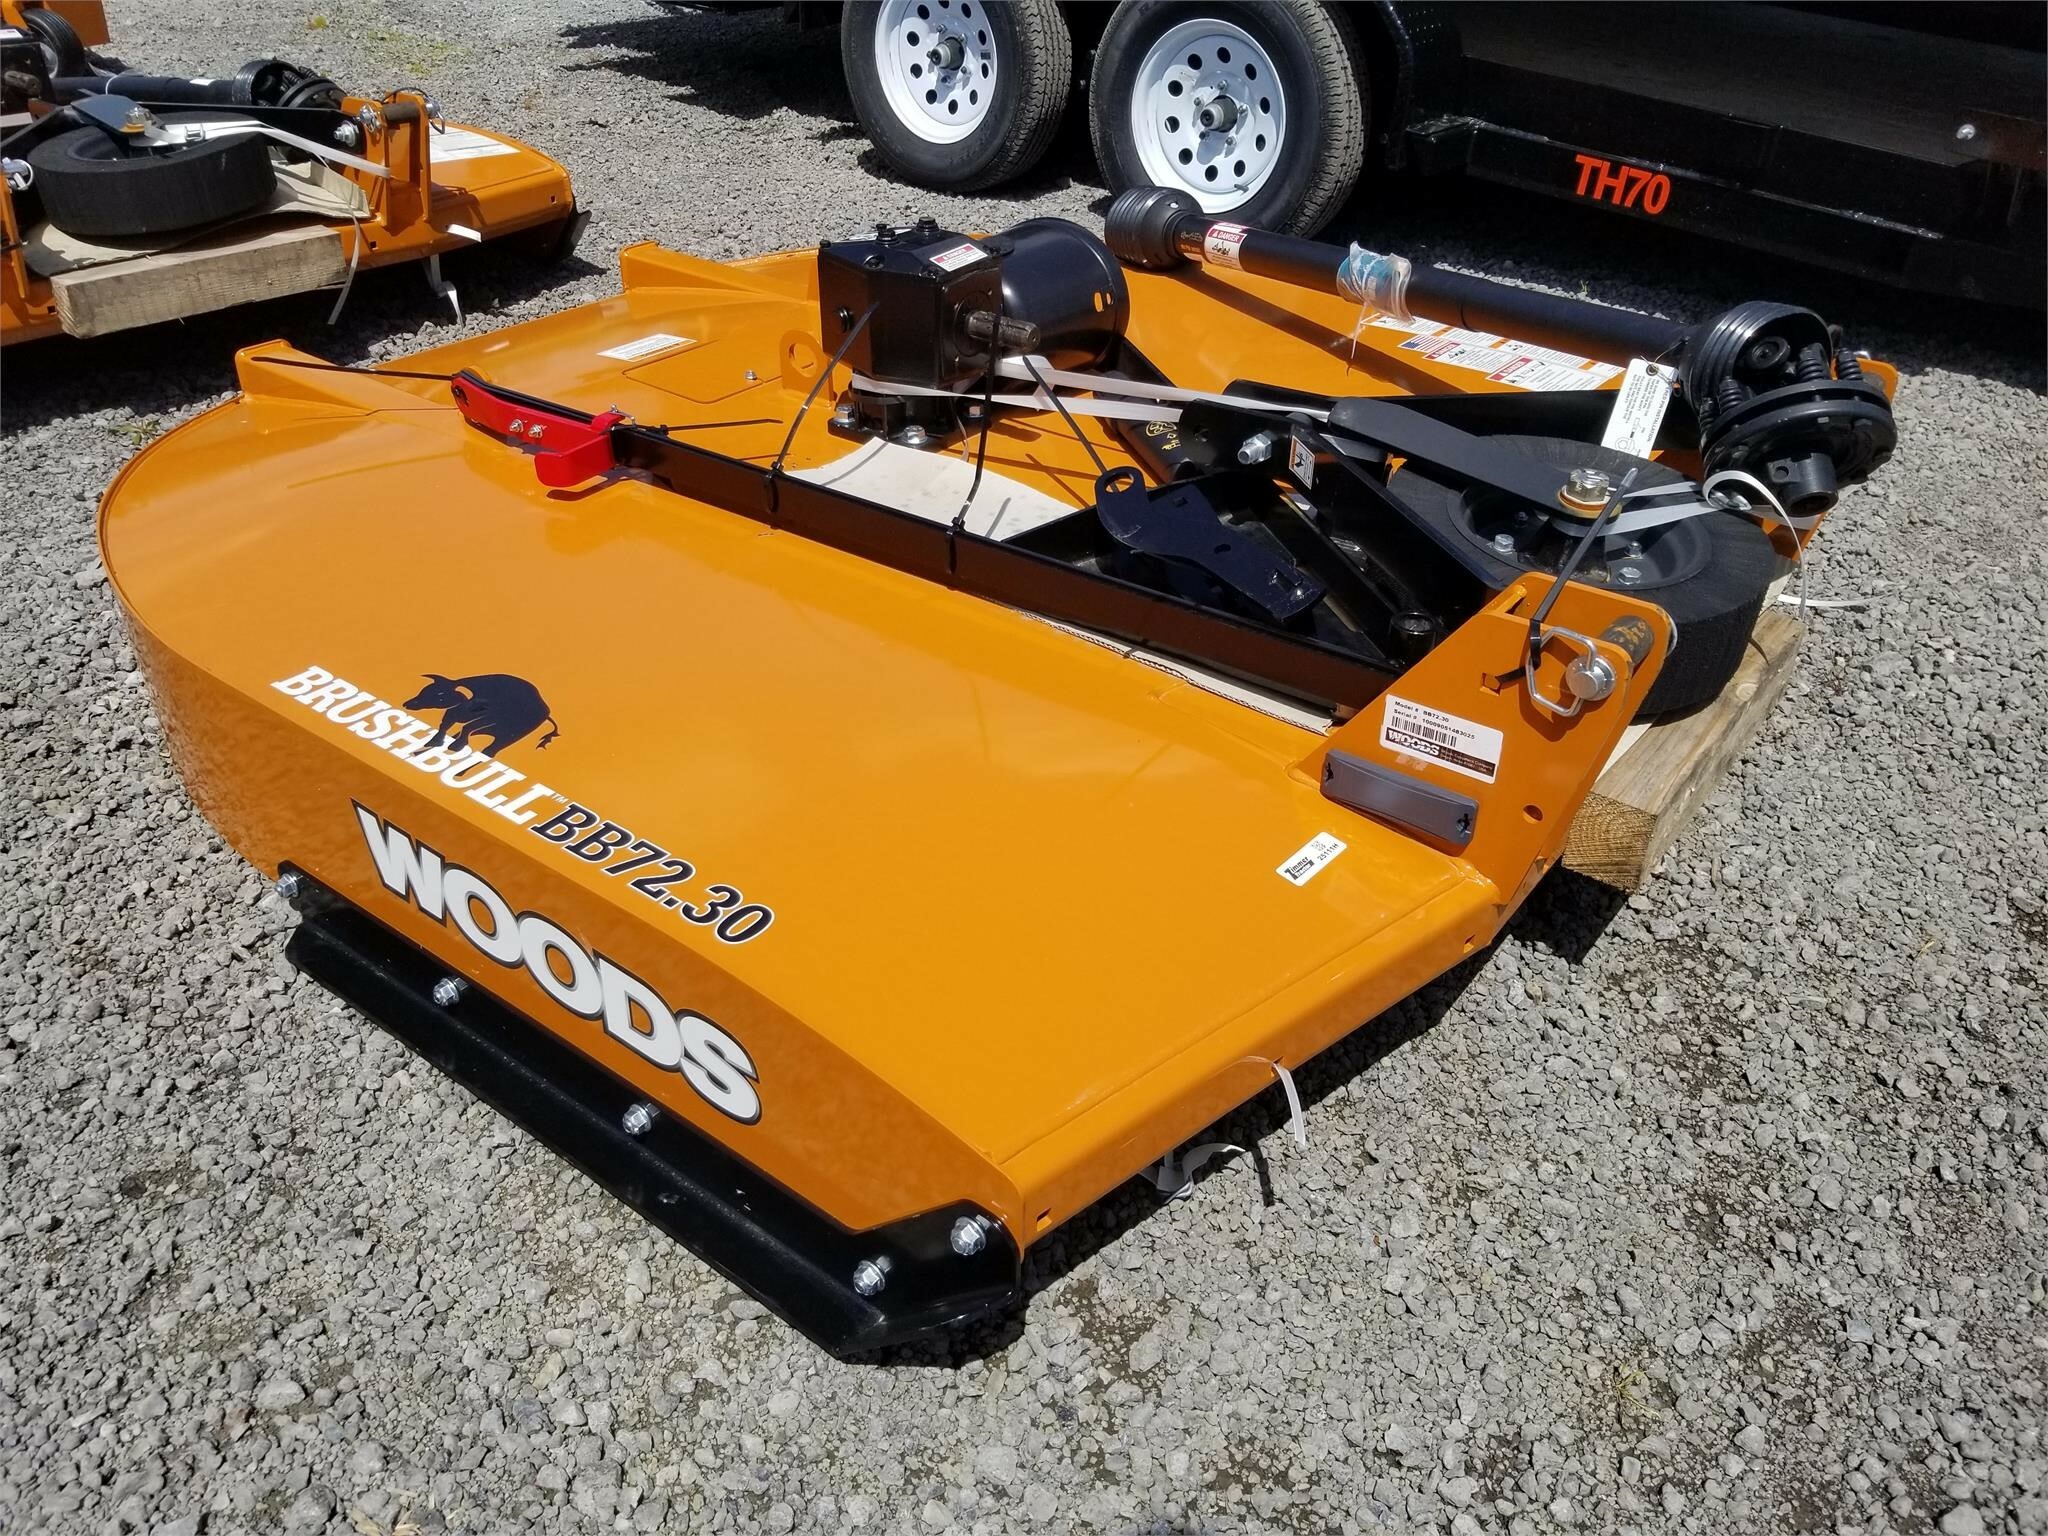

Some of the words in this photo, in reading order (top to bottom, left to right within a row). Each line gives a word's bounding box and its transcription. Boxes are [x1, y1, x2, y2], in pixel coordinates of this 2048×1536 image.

[1575, 154, 1671, 214] TH70
[1219, 231, 1240, 242] DANGER
[1393, 708, 1412, 719] Serial
[1395, 701, 1413, 711] Model
[1423, 711, 1449, 723] BB72.30
[1388, 729, 1440, 757] WOODS
[269, 665, 556, 825] BRUSHBULL
[527, 801, 775, 945] BB72.30
[350, 797, 762, 1126] WOODS
